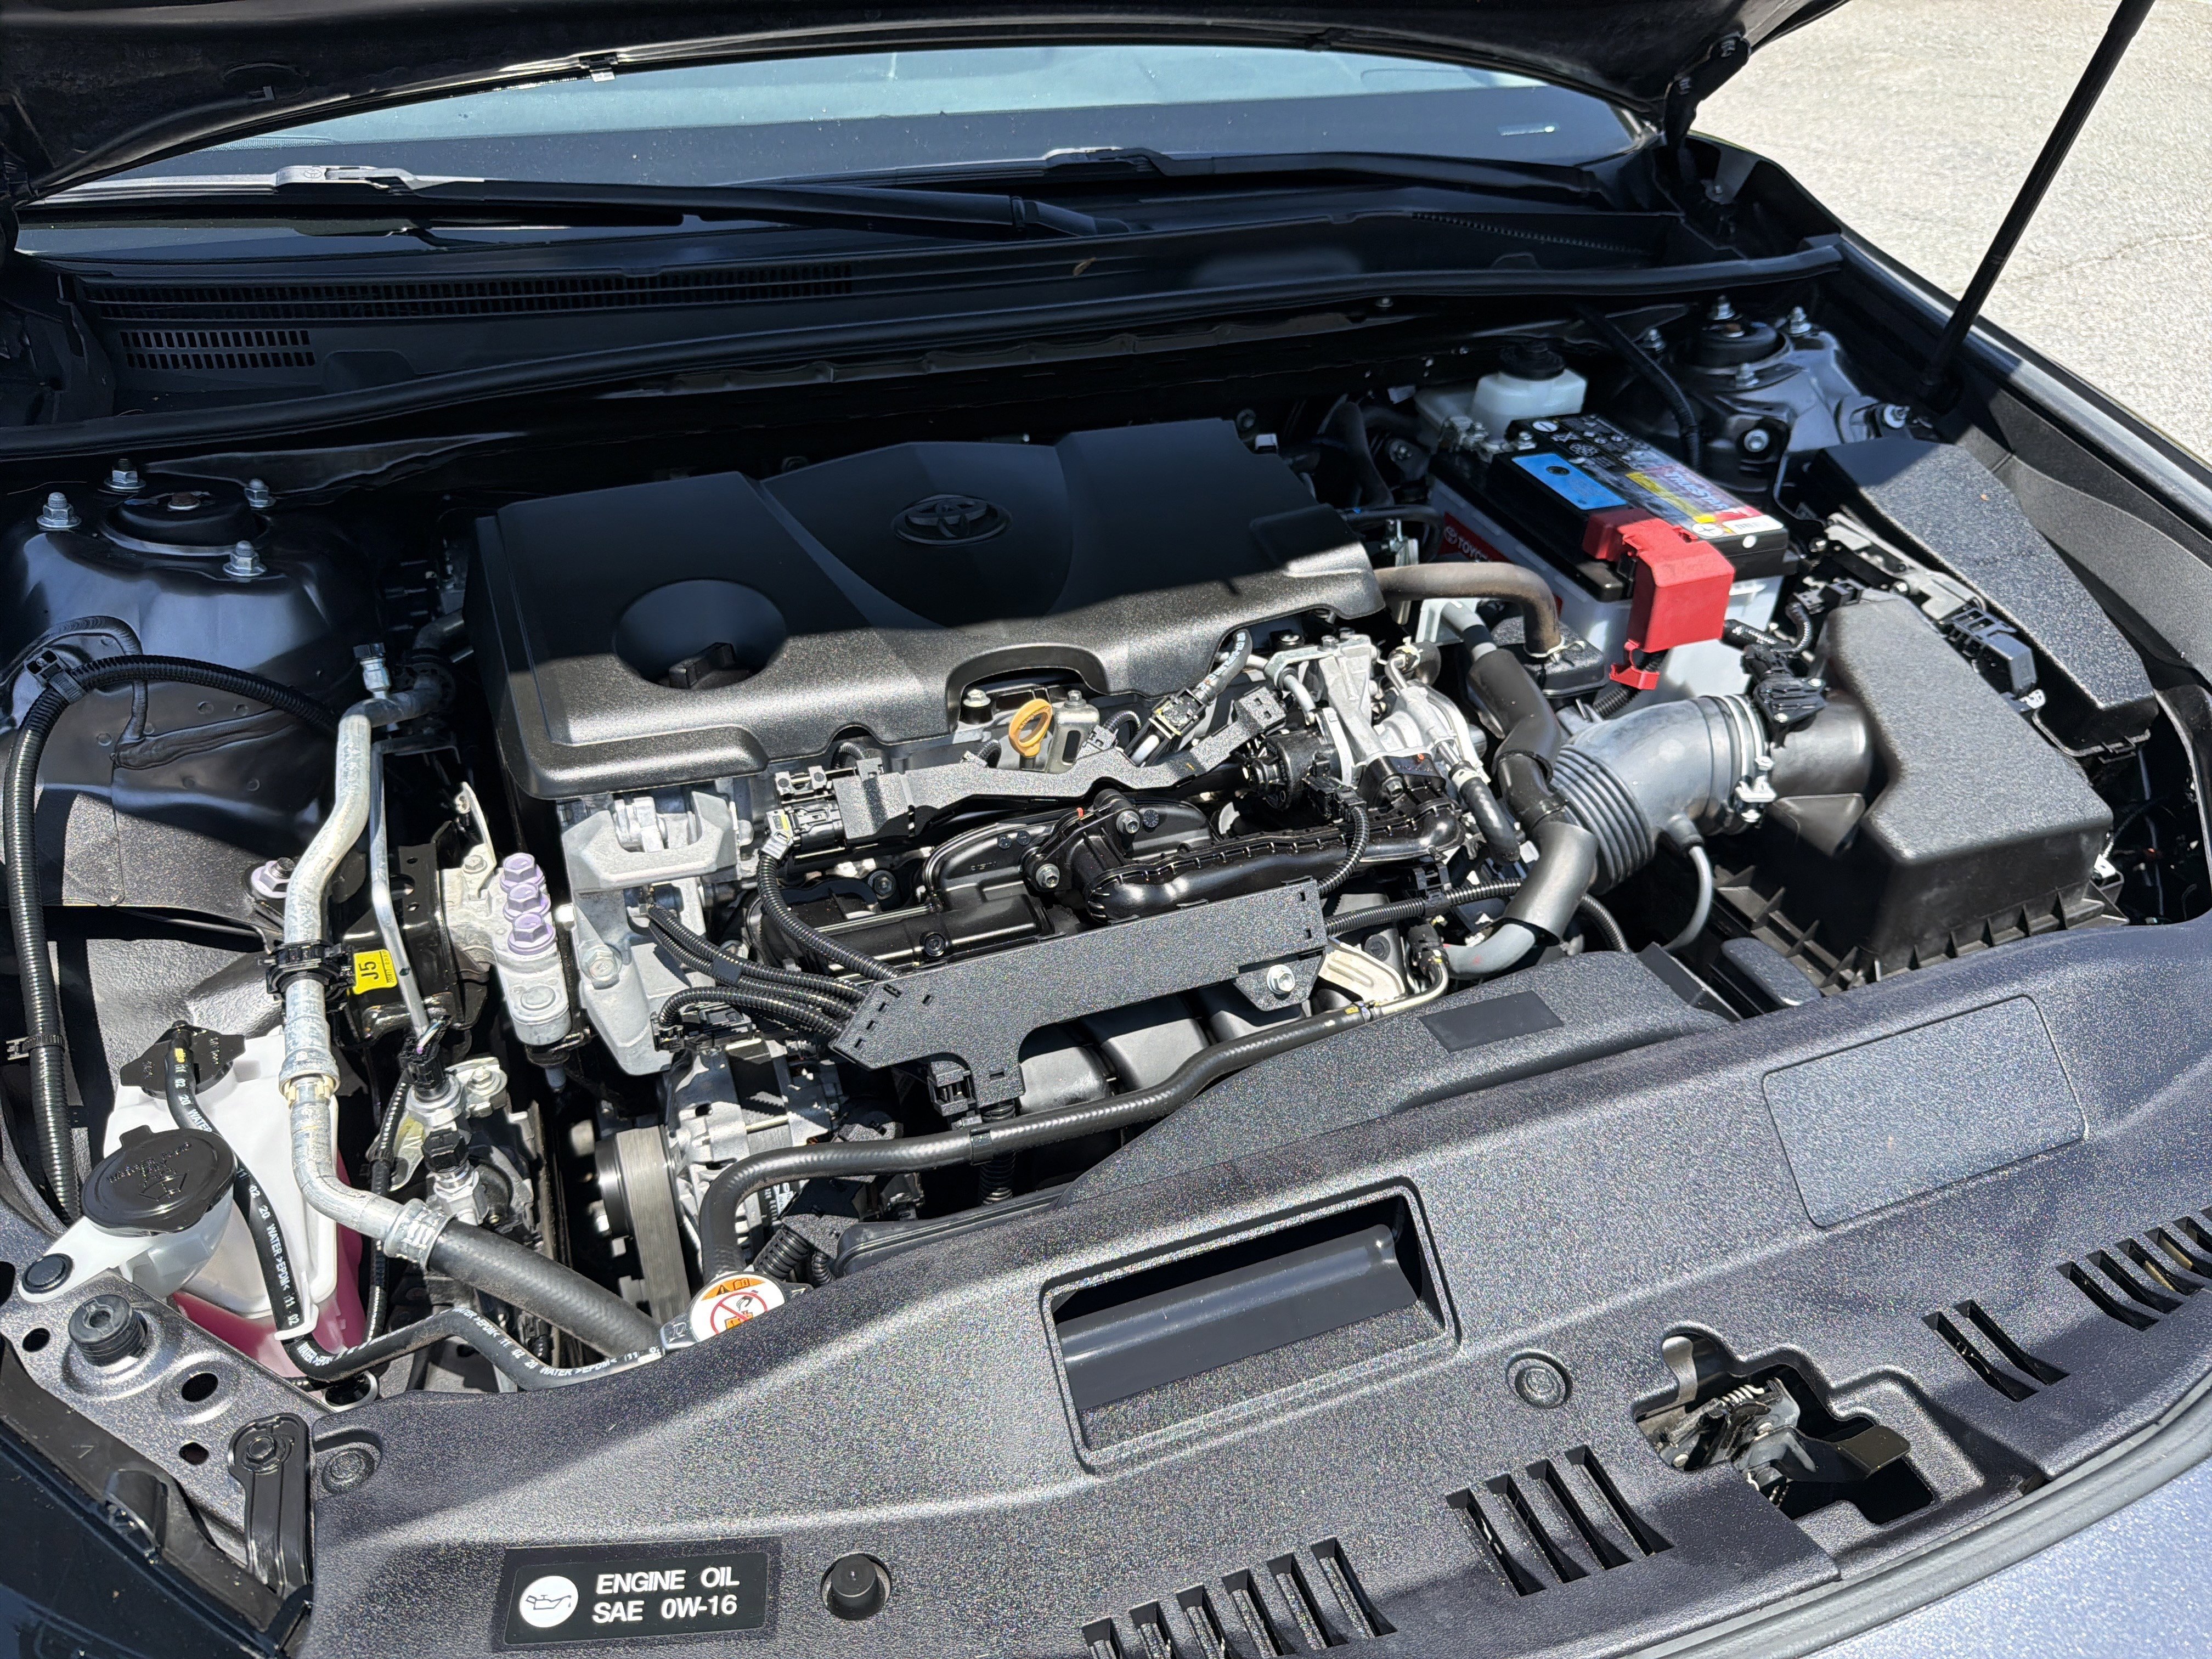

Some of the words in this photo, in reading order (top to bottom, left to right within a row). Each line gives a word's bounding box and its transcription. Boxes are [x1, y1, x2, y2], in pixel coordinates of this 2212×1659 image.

[1458, 536, 1491, 562] TOYO
[358, 962, 379, 980] J5
[175, 1078, 185, 1088] 02
[178, 1094, 191, 1105] 20
[188, 1108, 212, 1133] WATER
[249, 1184, 261, 1199] 02
[258, 1204, 271, 1220] 20
[266, 1223, 283, 1256] WATER
[287, 1314, 300, 1326] 02
[512, 1349, 525, 1358] 02
[524, 1359, 538, 1369] 20
[539, 1366, 572, 1376] WATER
[596, 1570, 686, 1594] ENGINE
[701, 1566, 740, 1588] OIL
[592, 1600, 645, 1623] SAE
[661, 1594, 737, 1619] 0W-16
